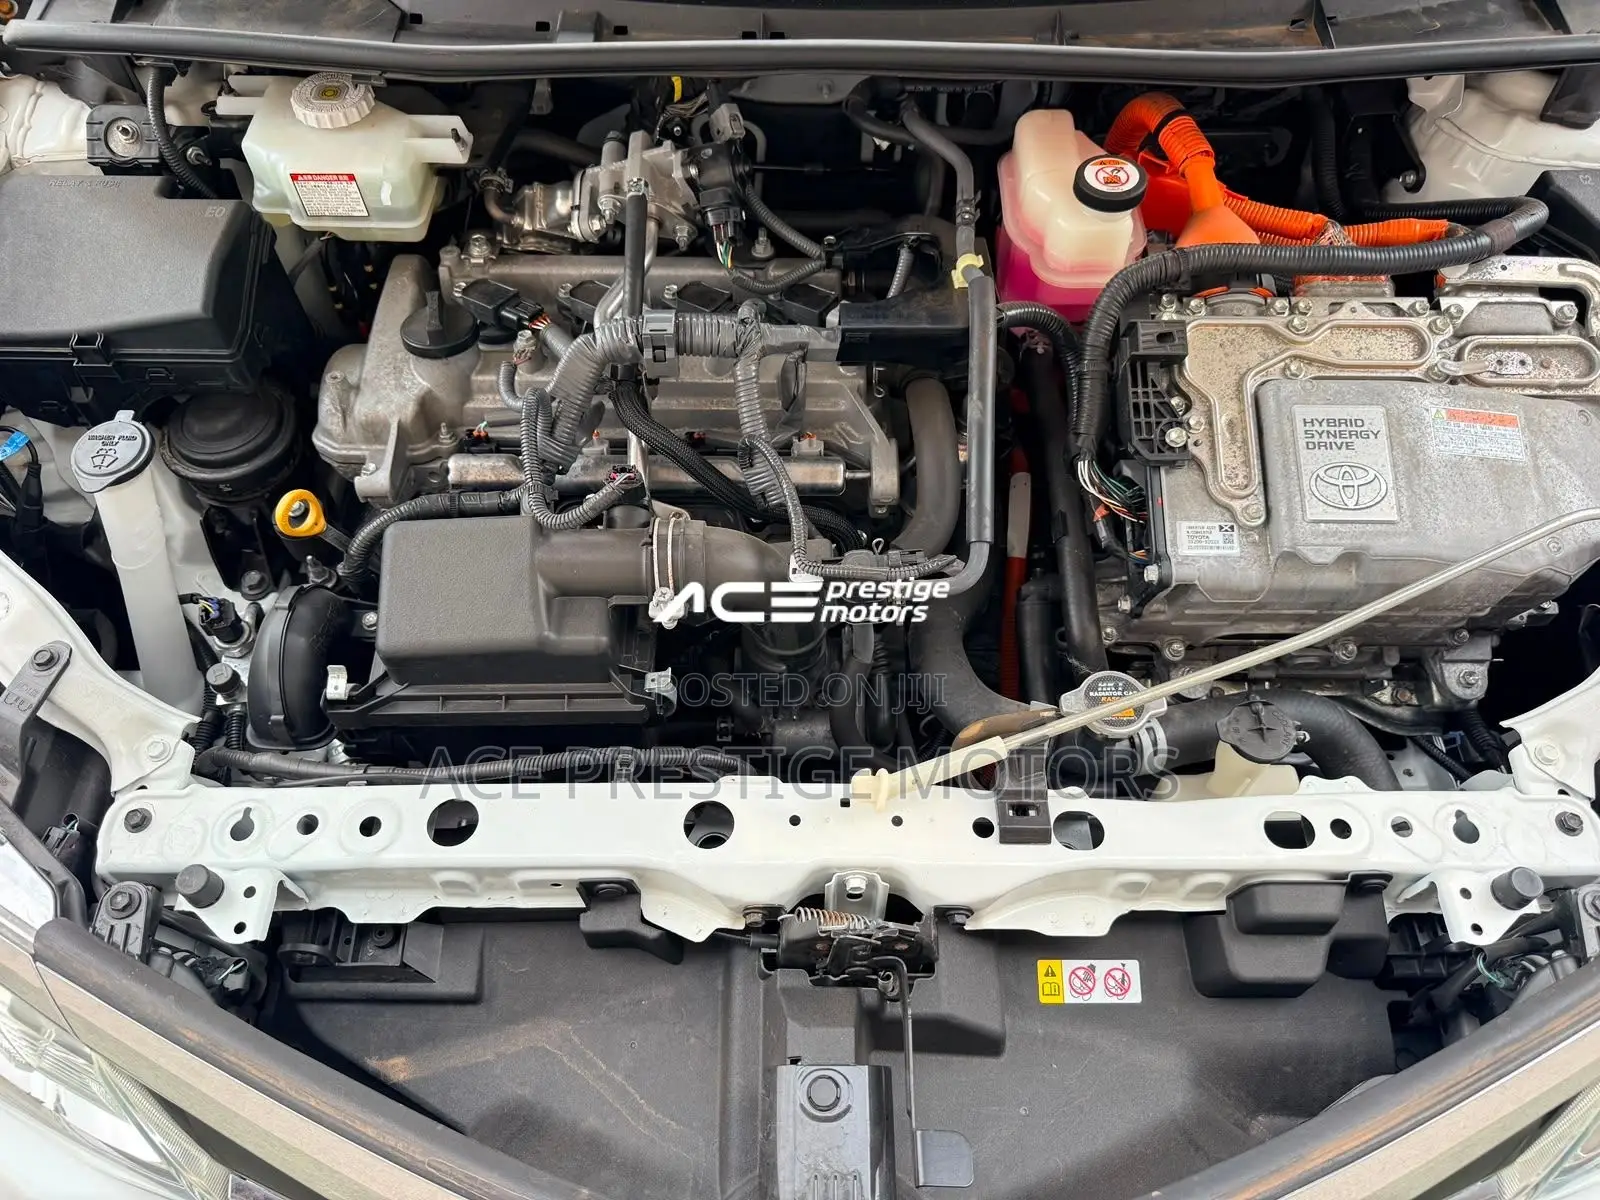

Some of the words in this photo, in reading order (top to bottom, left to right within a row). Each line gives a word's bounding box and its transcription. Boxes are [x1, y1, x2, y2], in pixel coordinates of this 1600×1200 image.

[1303, 418, 1365, 428] HYBRID
[1304, 429, 1381, 440] SYNERGY
[1305, 441, 1356, 451] DRIVE
